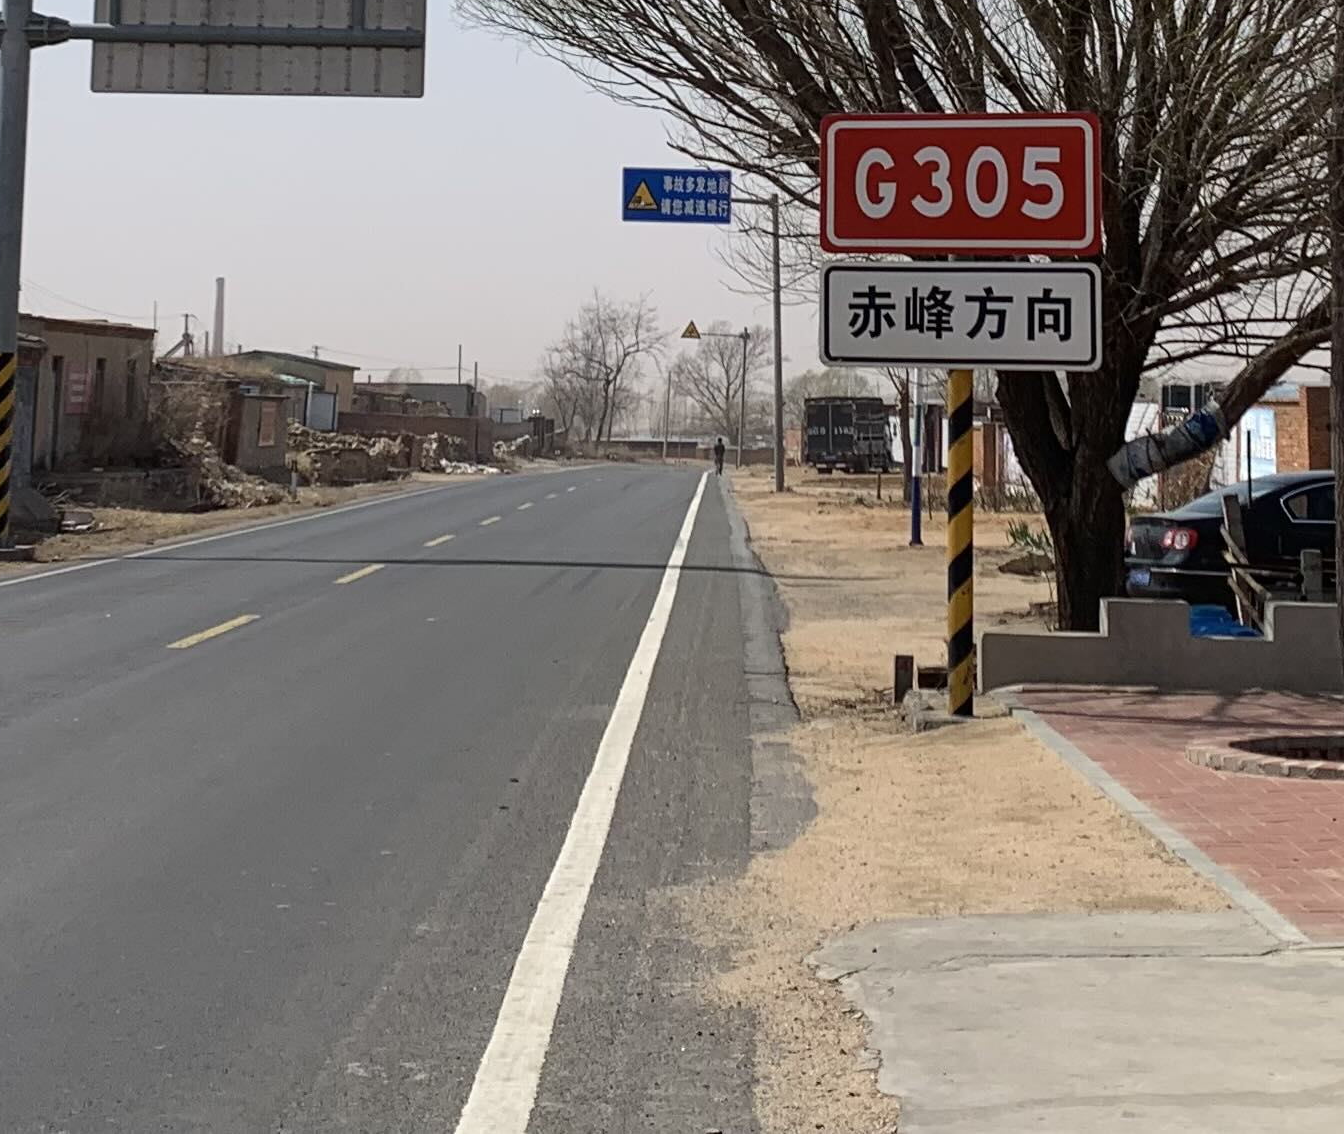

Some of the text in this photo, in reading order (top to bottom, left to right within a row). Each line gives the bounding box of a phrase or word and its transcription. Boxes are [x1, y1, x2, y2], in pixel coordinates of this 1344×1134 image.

[663, 175, 729, 194] 事故多发地段
[855, 146, 1065, 220] G305
[661, 197, 729, 217] 请您减速慢行
[848, 285, 1073, 342] 赤峰方向
